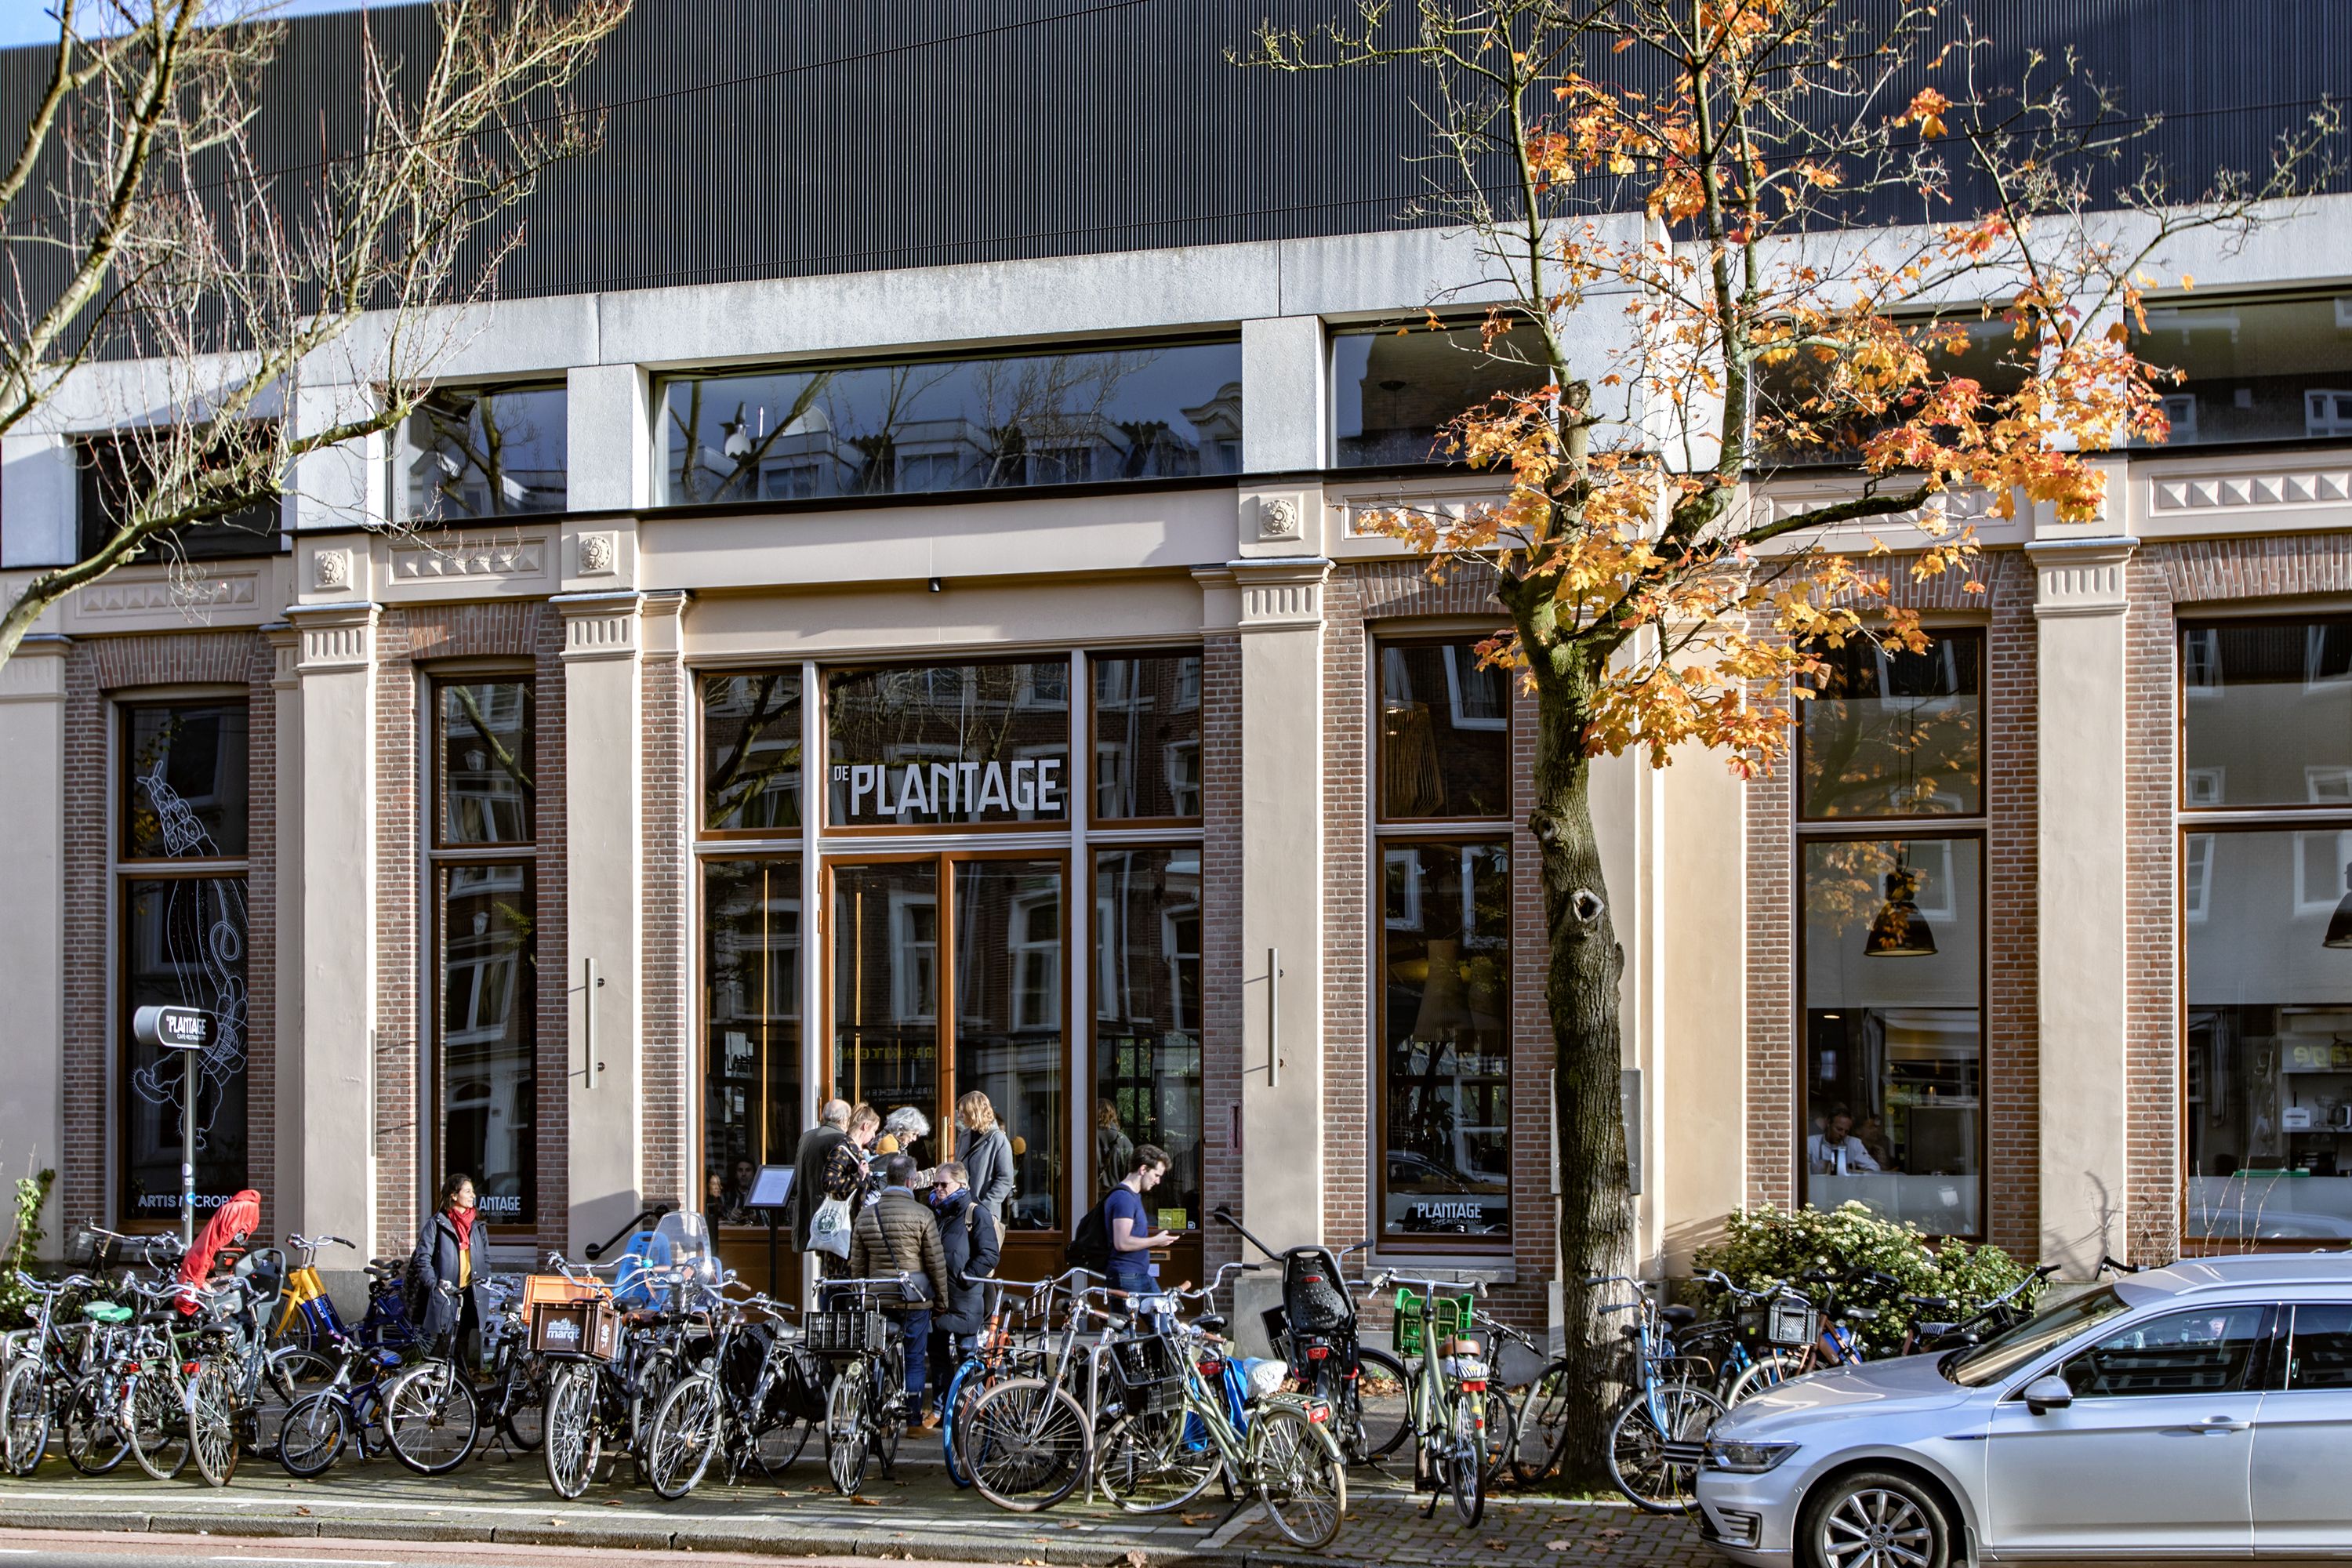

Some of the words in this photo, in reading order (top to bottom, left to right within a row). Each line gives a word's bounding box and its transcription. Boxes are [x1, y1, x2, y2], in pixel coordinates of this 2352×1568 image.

[833, 765, 850, 782] DE
[851, 759, 1061, 816] PLANTAGE
[168, 1016, 207, 1036] PLANTAGE
[138, 1194, 176, 1208] ARTIS
[474, 1196, 521, 1211] ANTAGE
[1417, 1202, 1483, 1218] PLANTAGE
[546, 1330, 580, 1342] marqt
